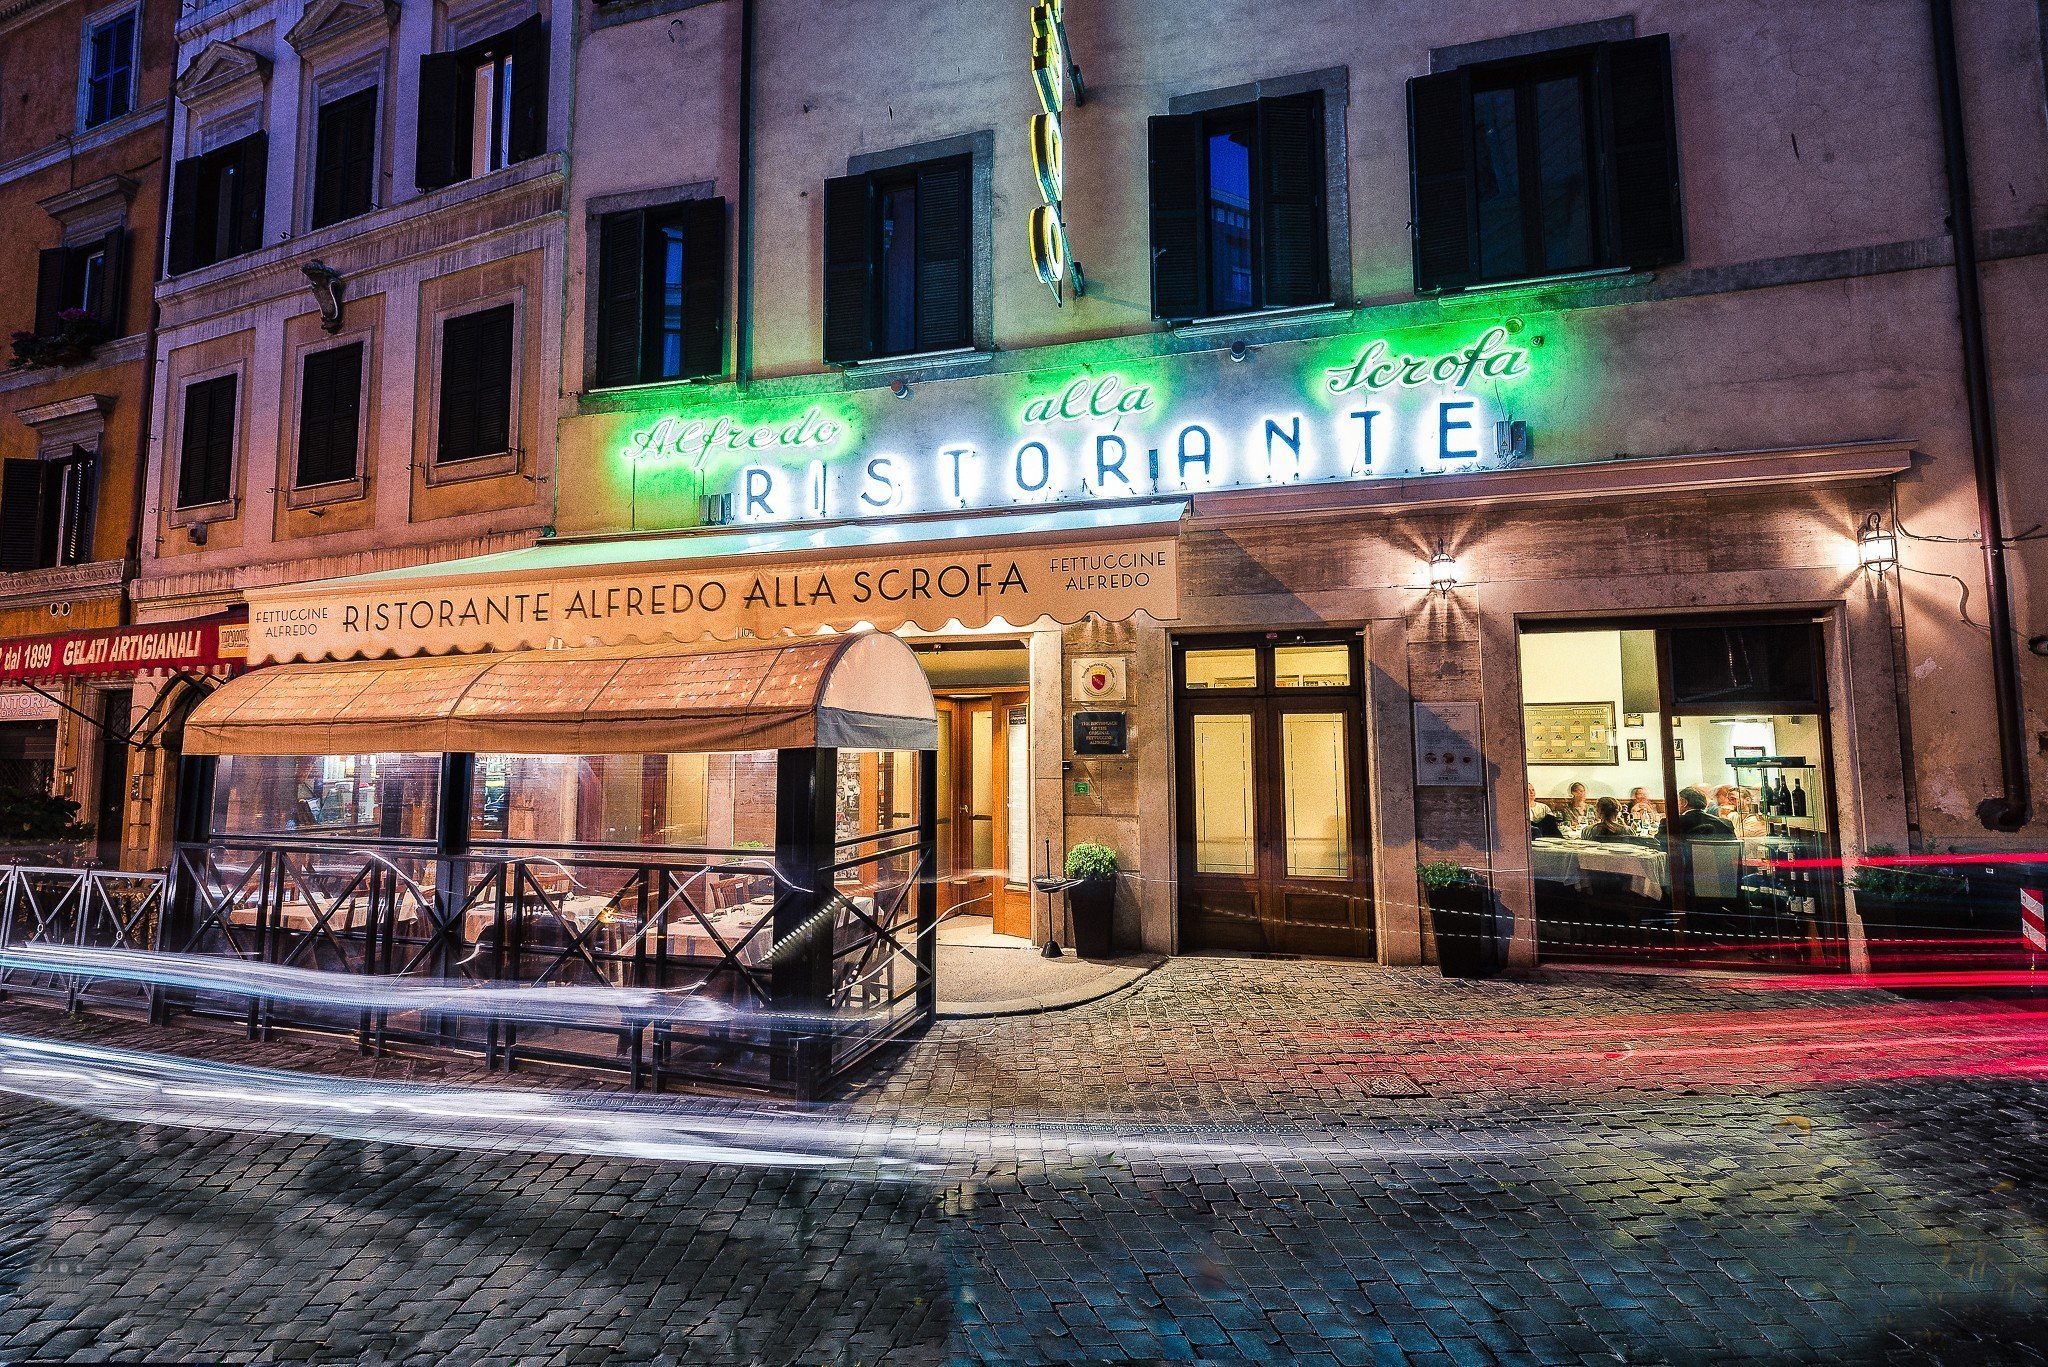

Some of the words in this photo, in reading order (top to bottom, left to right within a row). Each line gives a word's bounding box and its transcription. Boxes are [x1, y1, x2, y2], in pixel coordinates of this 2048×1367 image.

[624, 404, 843, 470] Alfredo
[1021, 374, 1156, 427] alla
[1326, 327, 1529, 395] Scrofa
[745, 401, 1478, 516] RISTORANTE
[1050, 550, 1166, 573] FETTUCCINE
[342, 592, 550, 633] RISTORANTE
[564, 581, 726, 620] ALFREDO
[743, 572, 838, 609] ALLA
[852, 560, 1029, 603] SCROFA
[1065, 572, 1150, 591] ALFREDO
[255, 606, 329, 624] FETTUCCINE
[264, 623, 318, 638] ALFREDO
[4, 645, 21, 670] dal
[24, 643, 52, 669] 1899
[62, 638, 109, 666] GELATI
[109, 630, 201, 662] ARTIGIANALI
